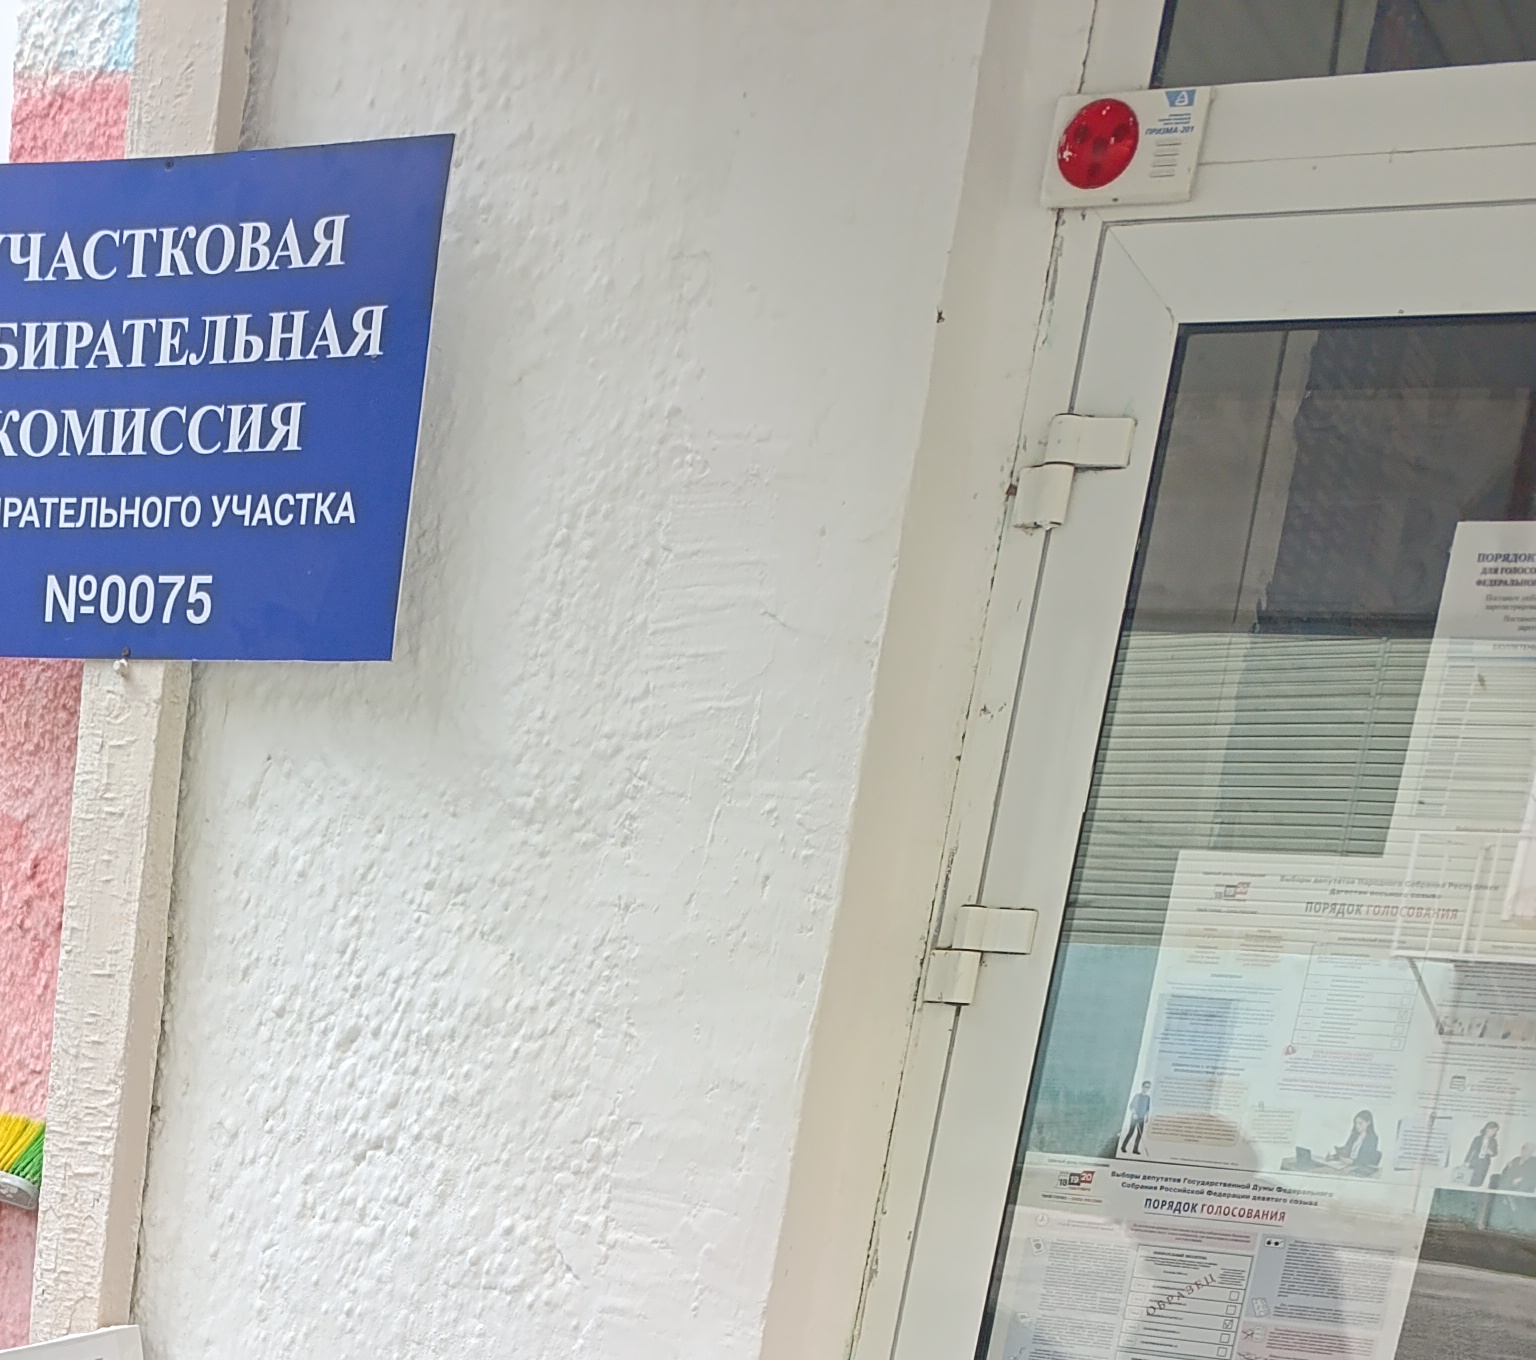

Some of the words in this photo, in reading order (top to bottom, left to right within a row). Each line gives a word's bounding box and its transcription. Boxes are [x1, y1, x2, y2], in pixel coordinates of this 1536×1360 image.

[211, 491, 356, 527] УЧАСТКА
[44, 574, 214, 625] №0075
[1305, 901, 1363, 917] ПОРЯДОК
[1366, 904, 1458, 919] ГОЛОСОВАНИЯ
[1110, 1170, 1140, 1180] Выборы
[1142, 1174, 1181, 1184] депутатов
[1183, 1177, 1250, 1190] Государственной
[1121, 1181, 1157, 1190] Собрания
[1159, 1185, 1204, 1195] Российской
[1206, 1190, 1250, 1199] Федерации
[1144, 1198, 1198, 1214] ПОРЯДОК
[1200, 1203, 1286, 1222] ГОЛОСОВАНИЯ
[1146, 1273, 1216, 1316] ОБРАЗЕЦ
